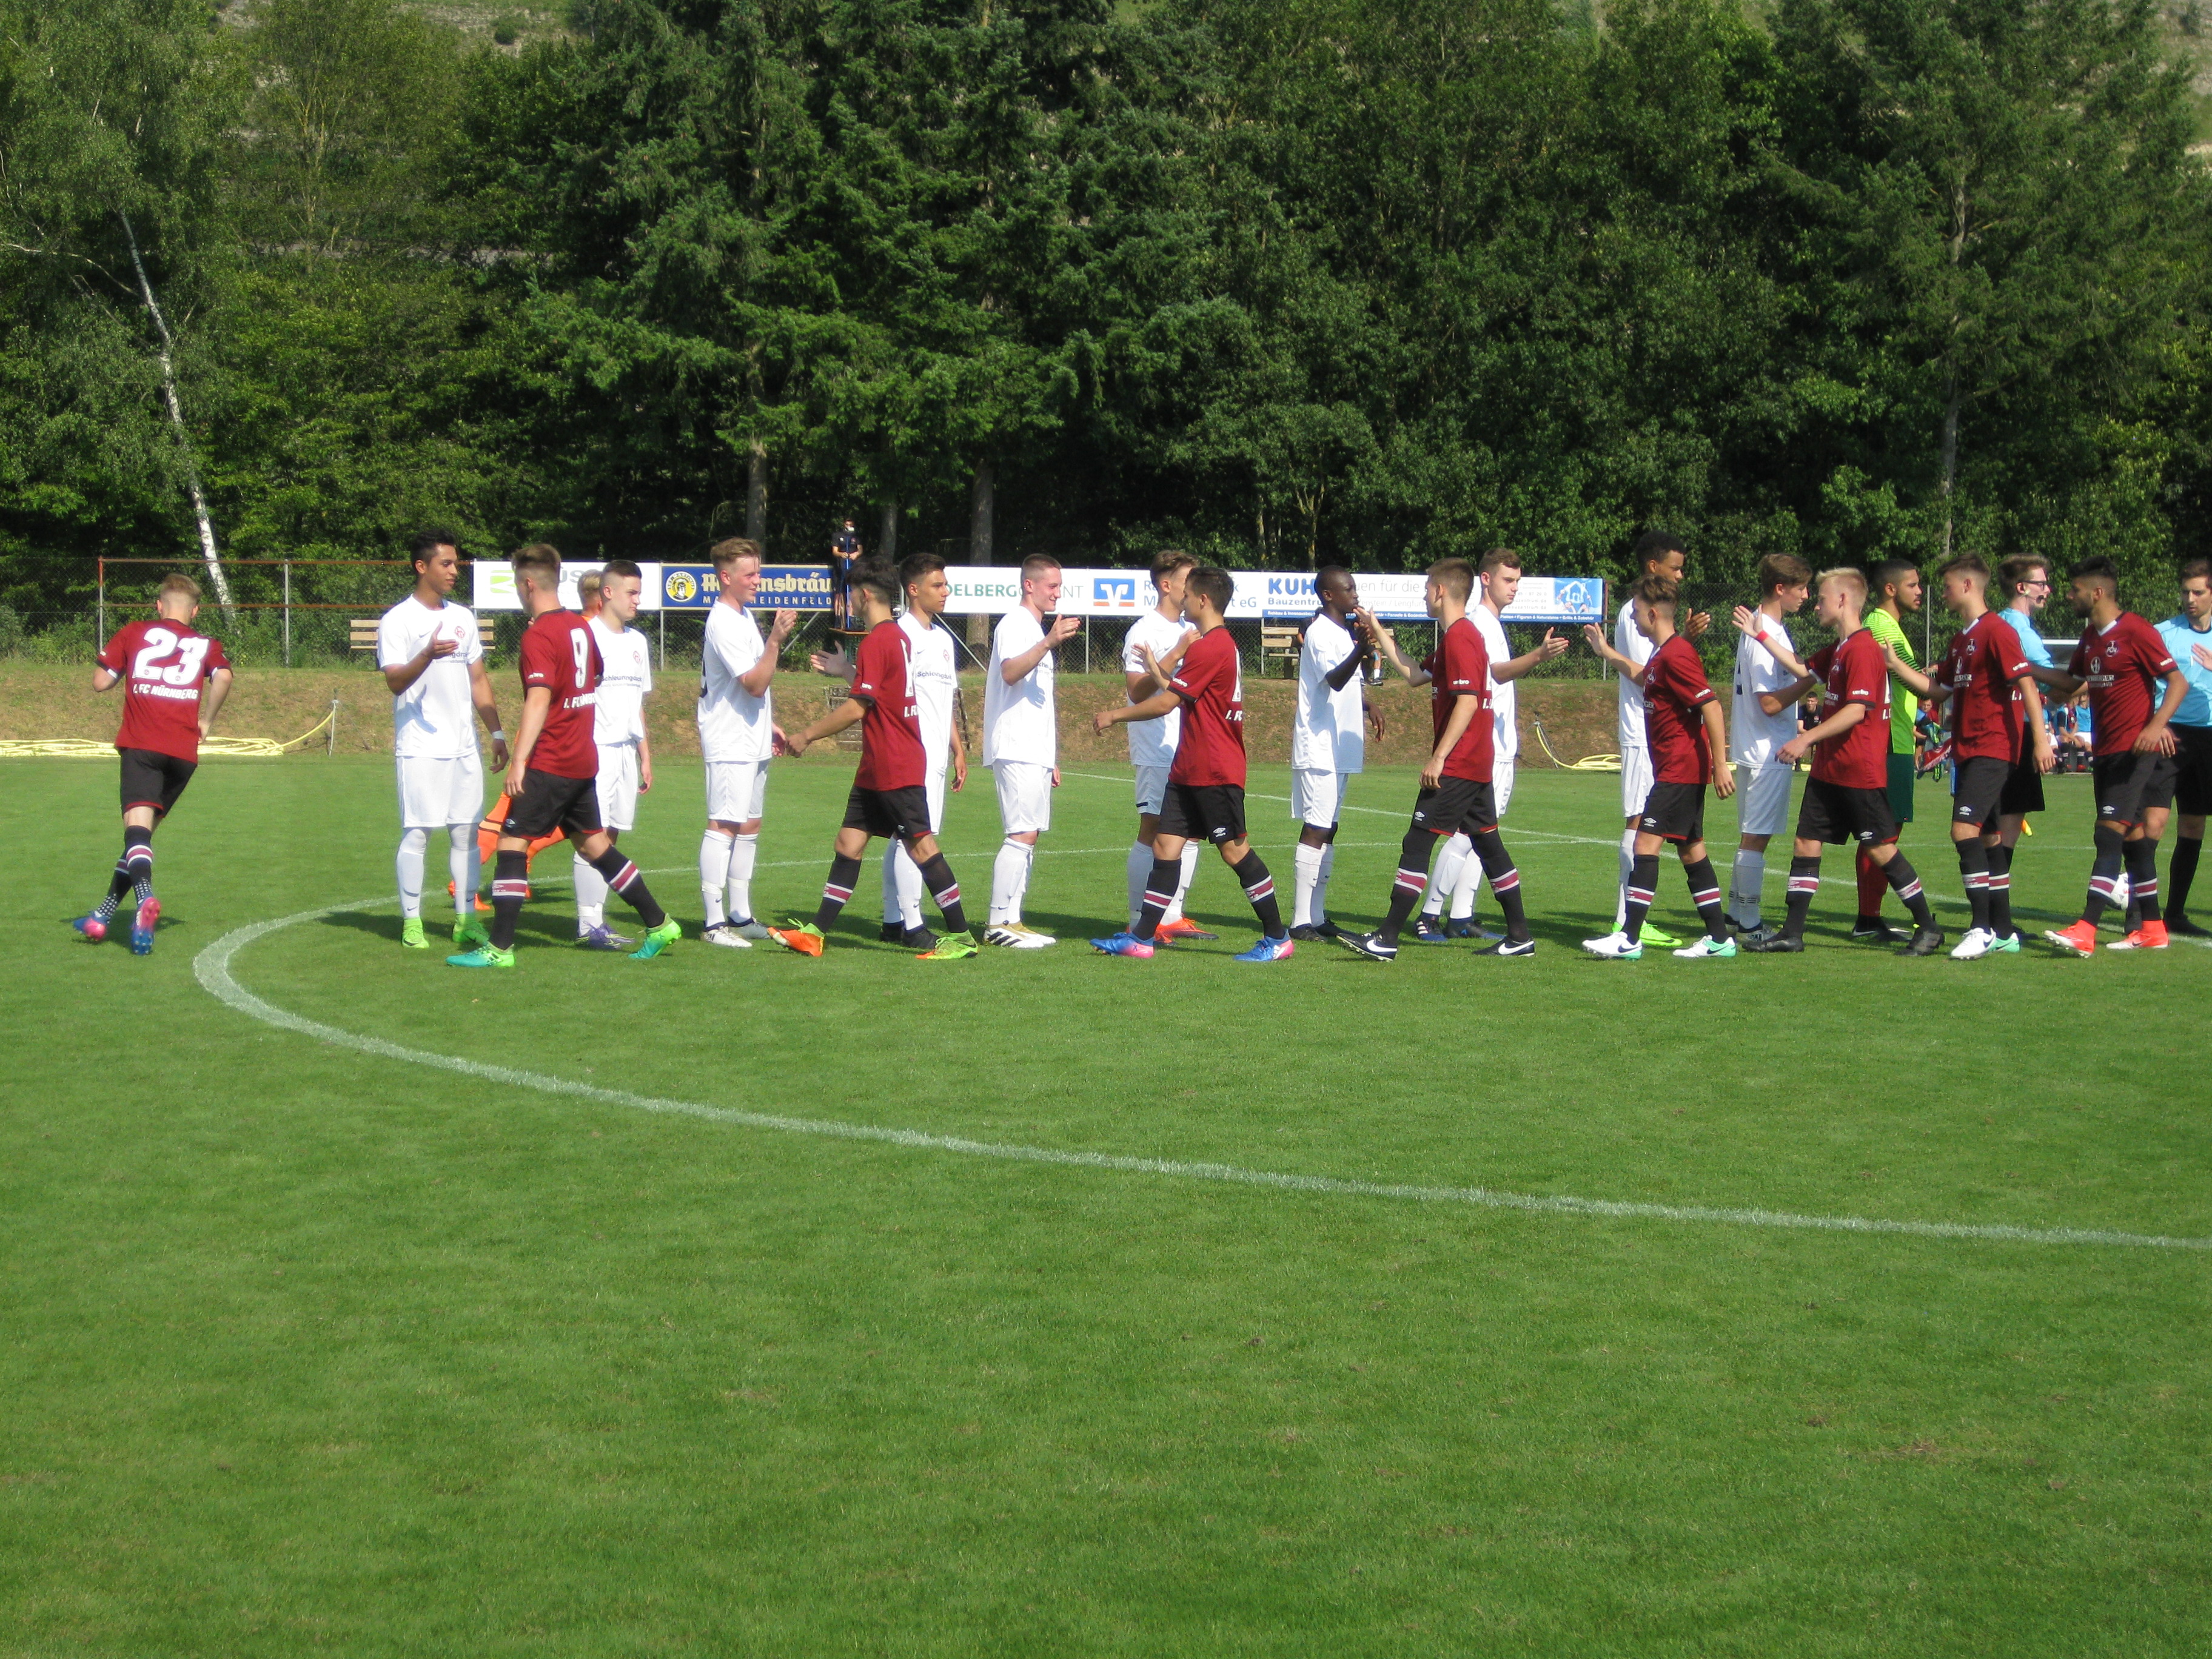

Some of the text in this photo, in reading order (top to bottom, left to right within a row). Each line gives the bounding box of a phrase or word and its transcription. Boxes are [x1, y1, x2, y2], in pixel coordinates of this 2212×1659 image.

[1269, 578, 1316, 595] KUH
[1381, 579, 1399, 592] für
[1402, 580, 1419, 592] die
[703, 596, 832, 605] MAHEIDENFELD
[1240, 597, 1257, 607] eG
[132, 628, 209, 685] 23
[570, 628, 588, 688] 9
[138, 685, 149, 694] FC
[150, 685, 199, 700] NÜRNBERG
